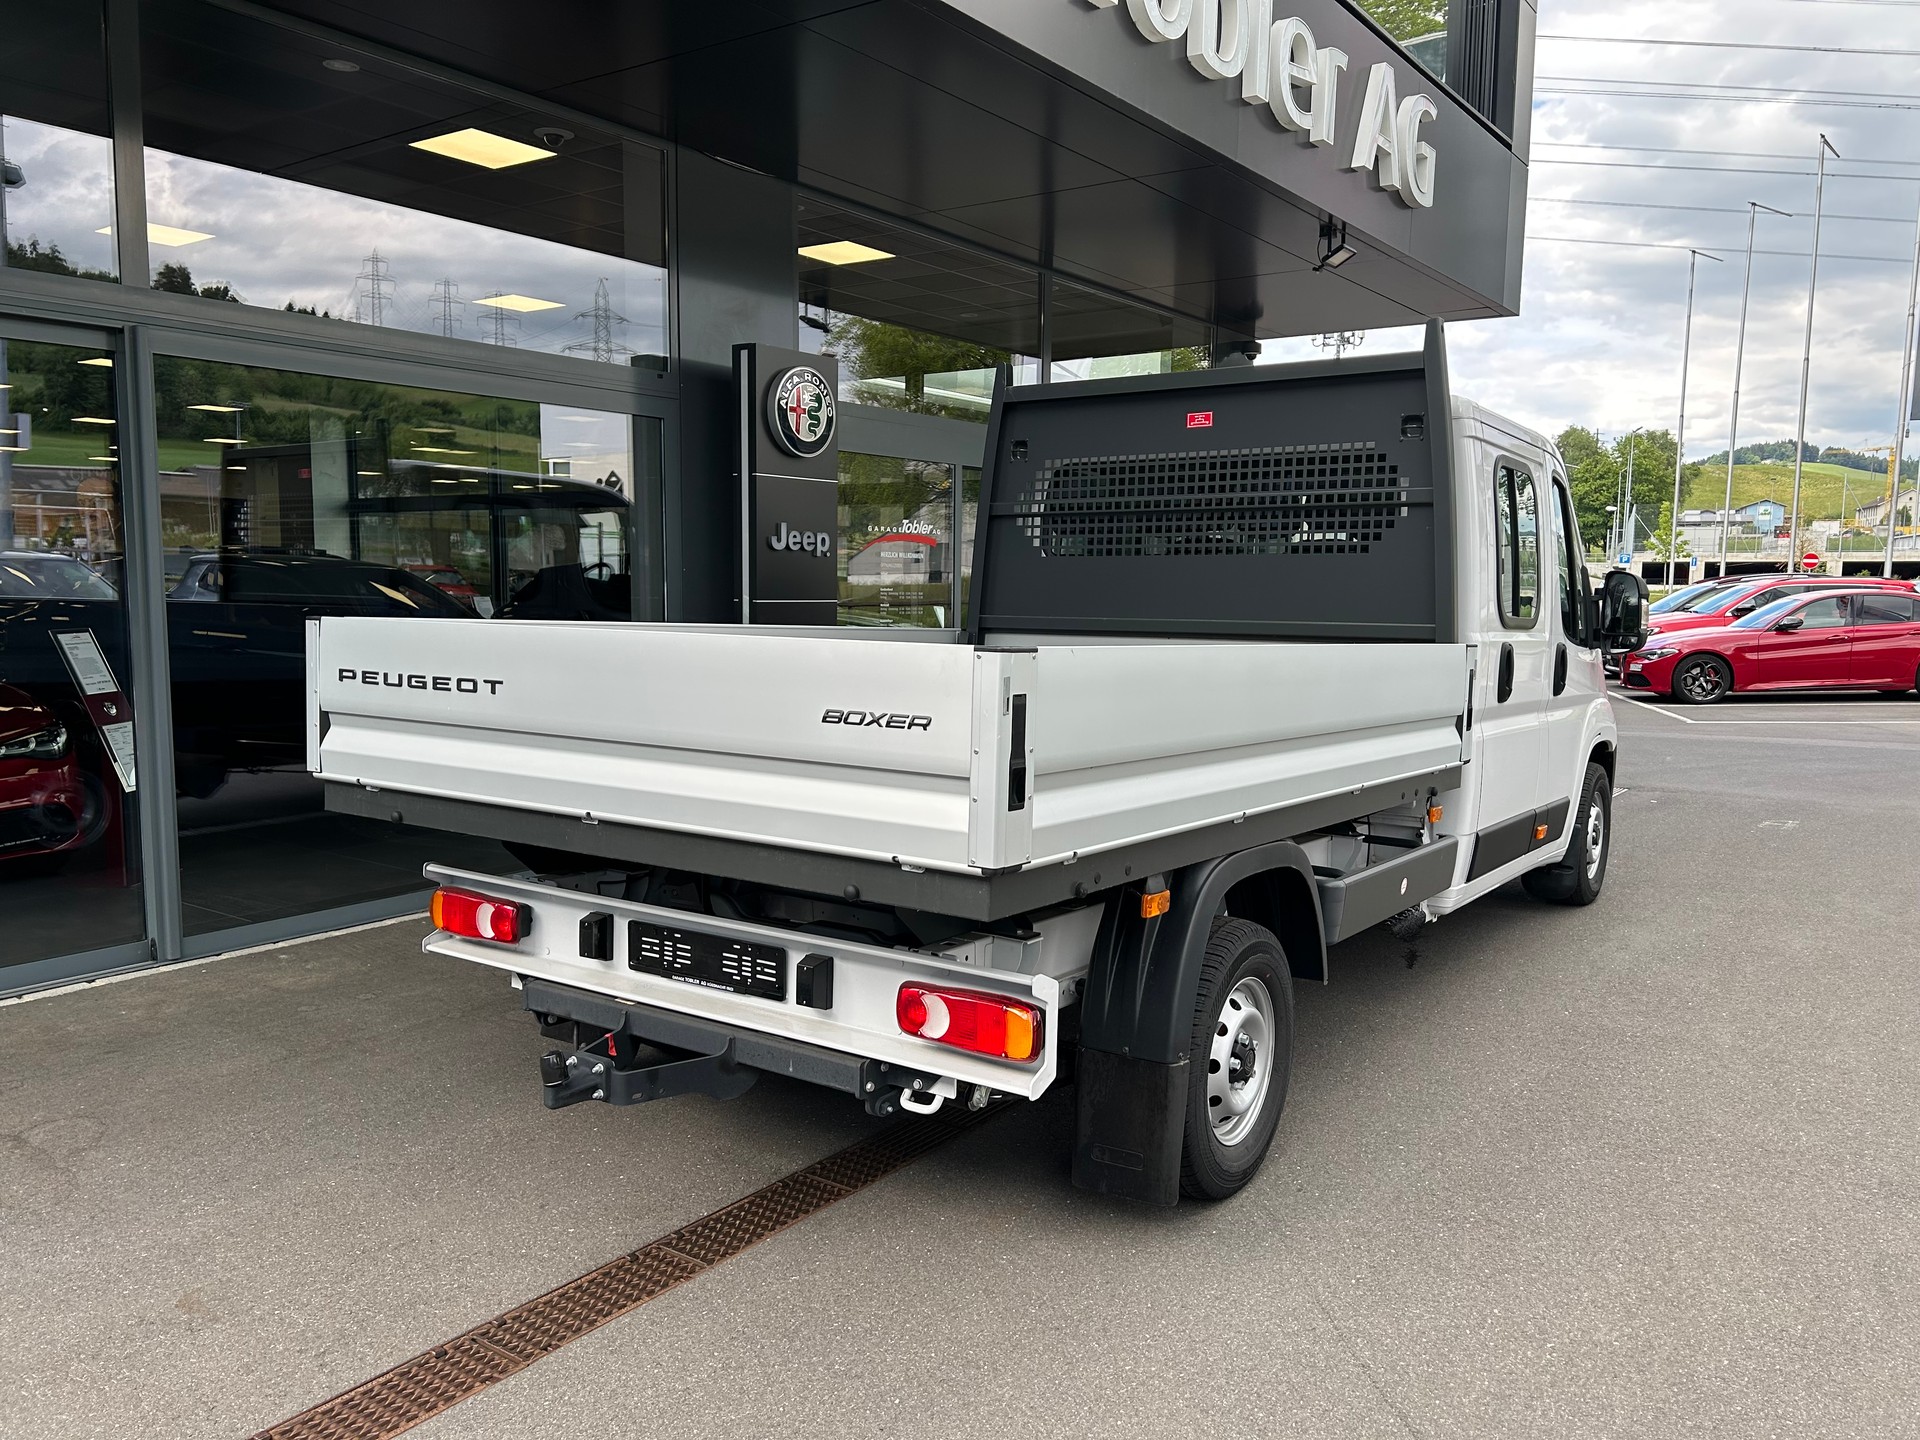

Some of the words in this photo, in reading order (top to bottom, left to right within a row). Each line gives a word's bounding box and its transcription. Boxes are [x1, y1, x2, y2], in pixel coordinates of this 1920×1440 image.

[1351, 62, 1438, 208] AG
[780, 375, 800, 409] ALFA
[804, 372, 833, 417] ROMEO
[901, 519, 934, 535] Tobler
[338, 668, 504, 695] PEUGEOT
[821, 708, 933, 731] BOXER
